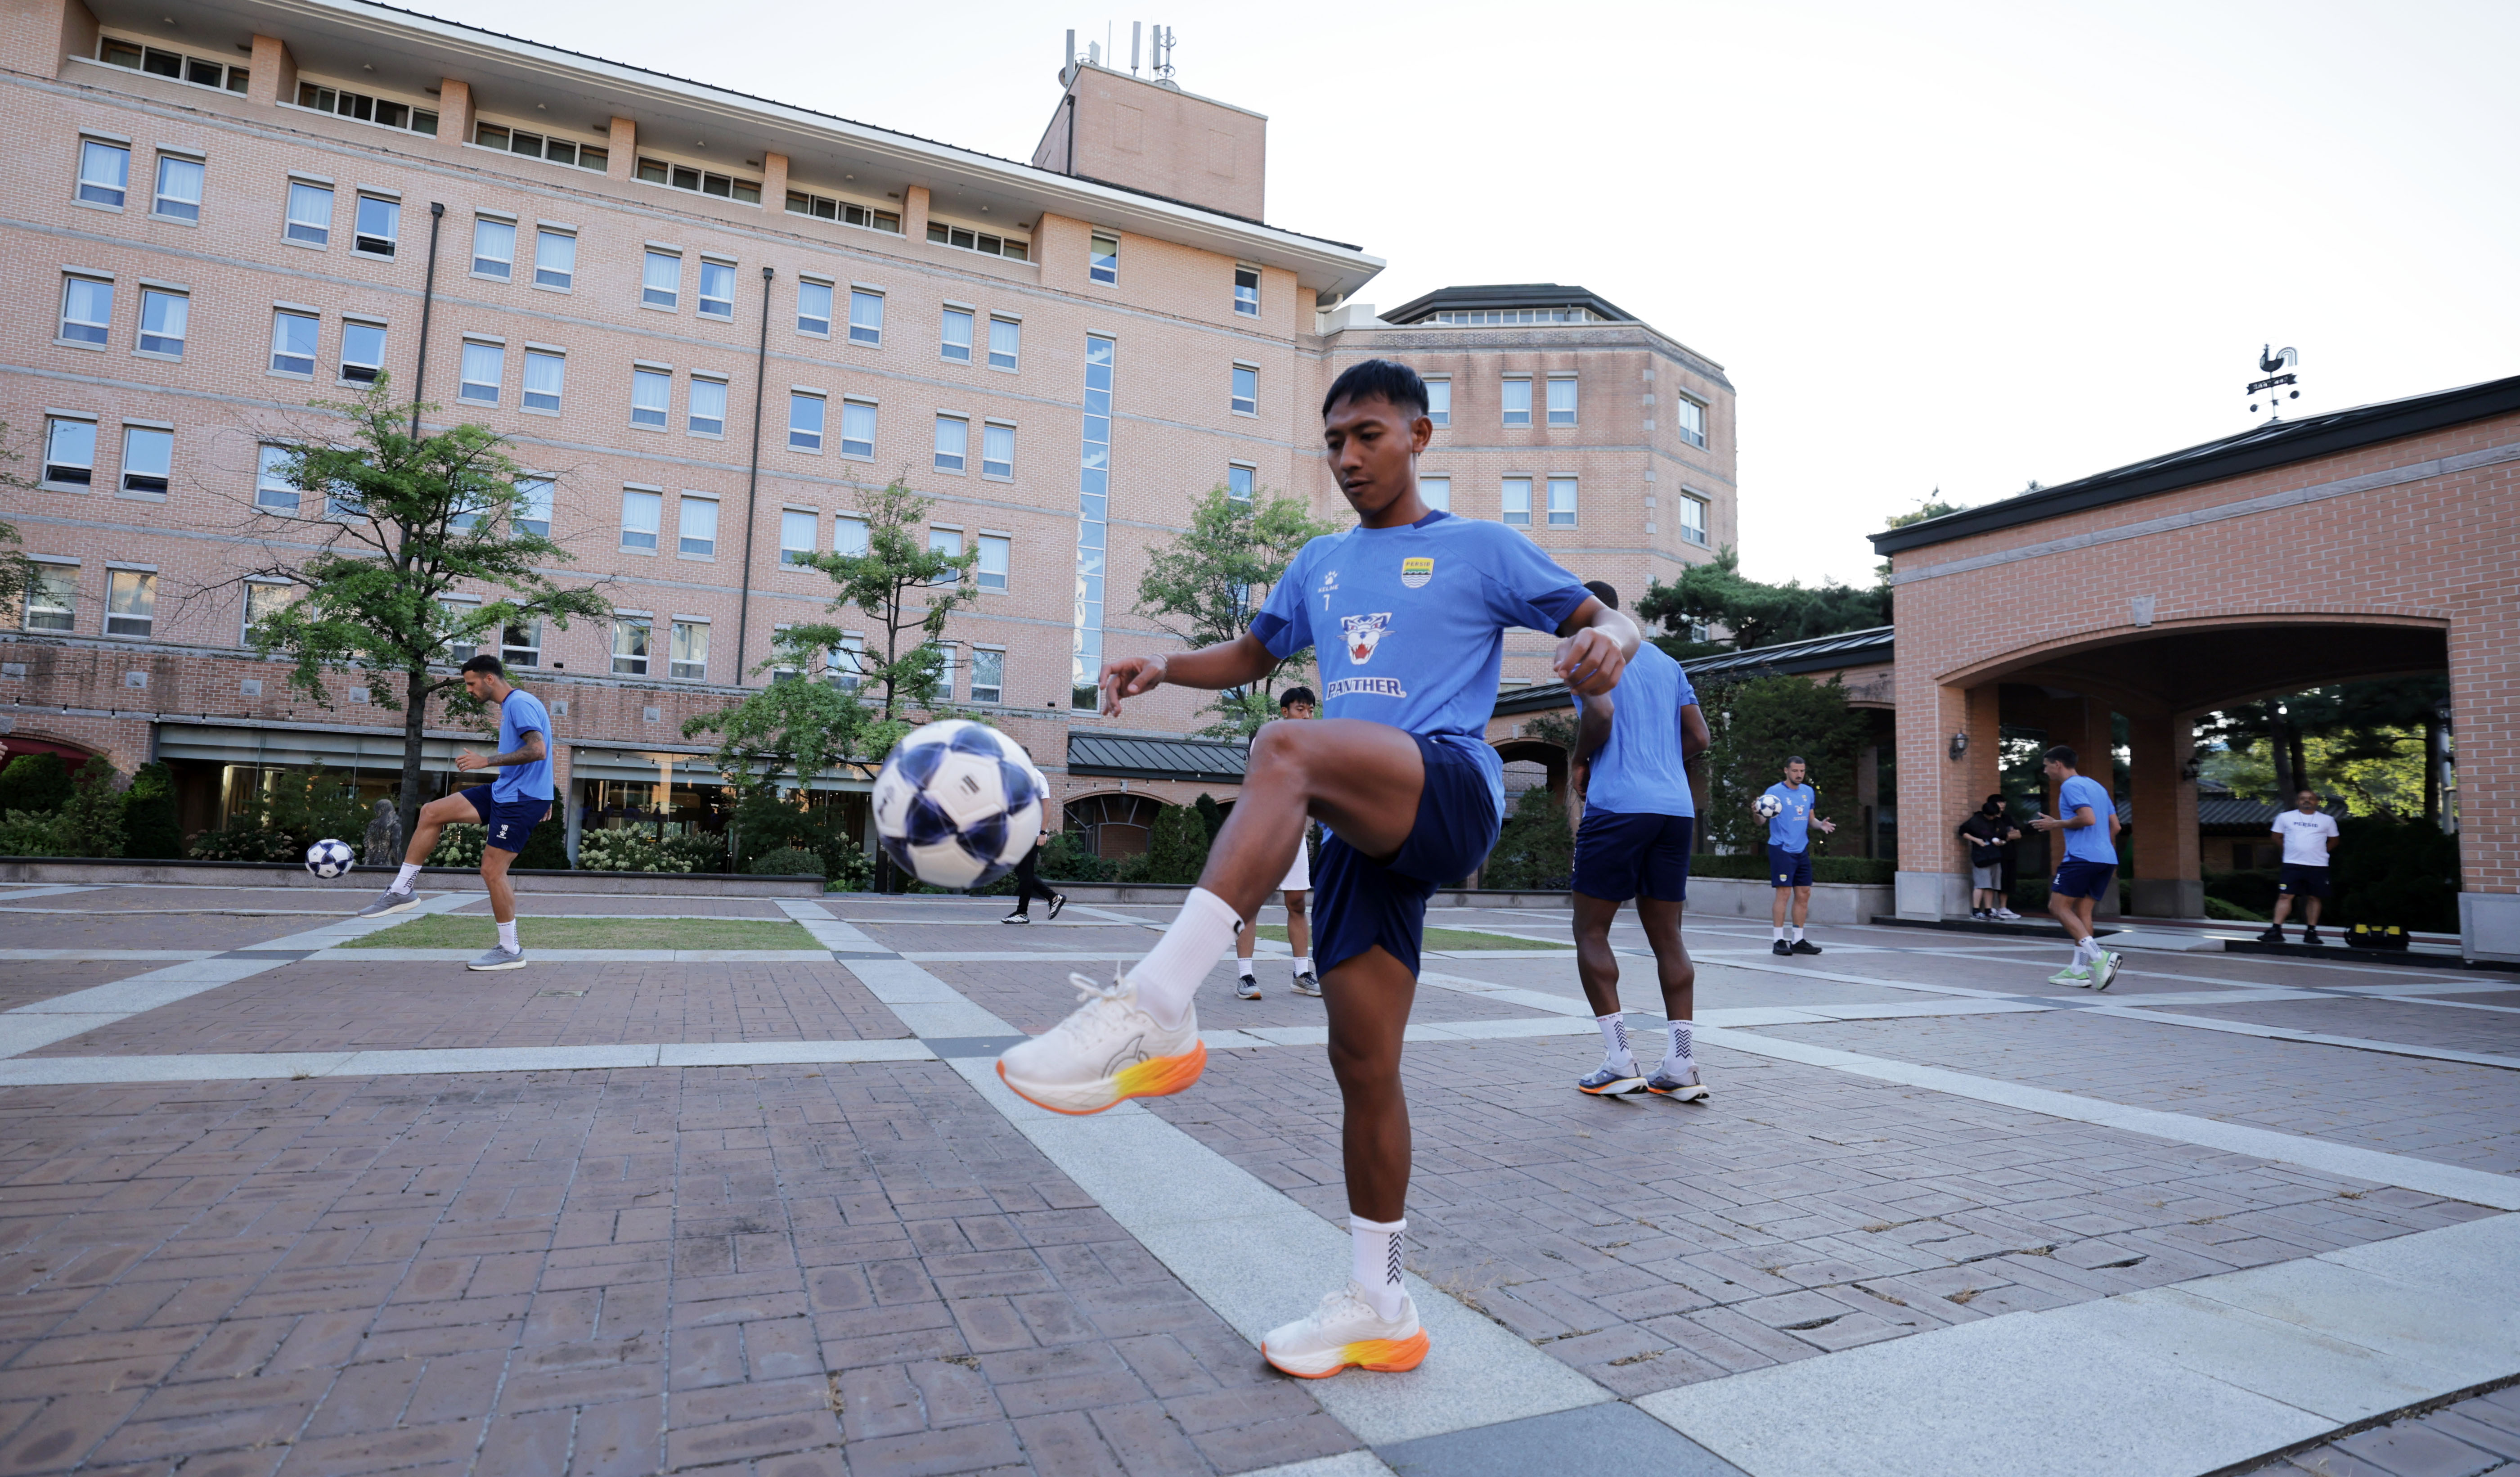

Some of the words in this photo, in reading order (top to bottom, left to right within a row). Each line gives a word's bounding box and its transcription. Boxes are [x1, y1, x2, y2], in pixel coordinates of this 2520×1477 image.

[1318, 584, 1339, 593] KELME
[1323, 594, 1330, 612] 7
[1326, 678, 1401, 699] PANTHER
